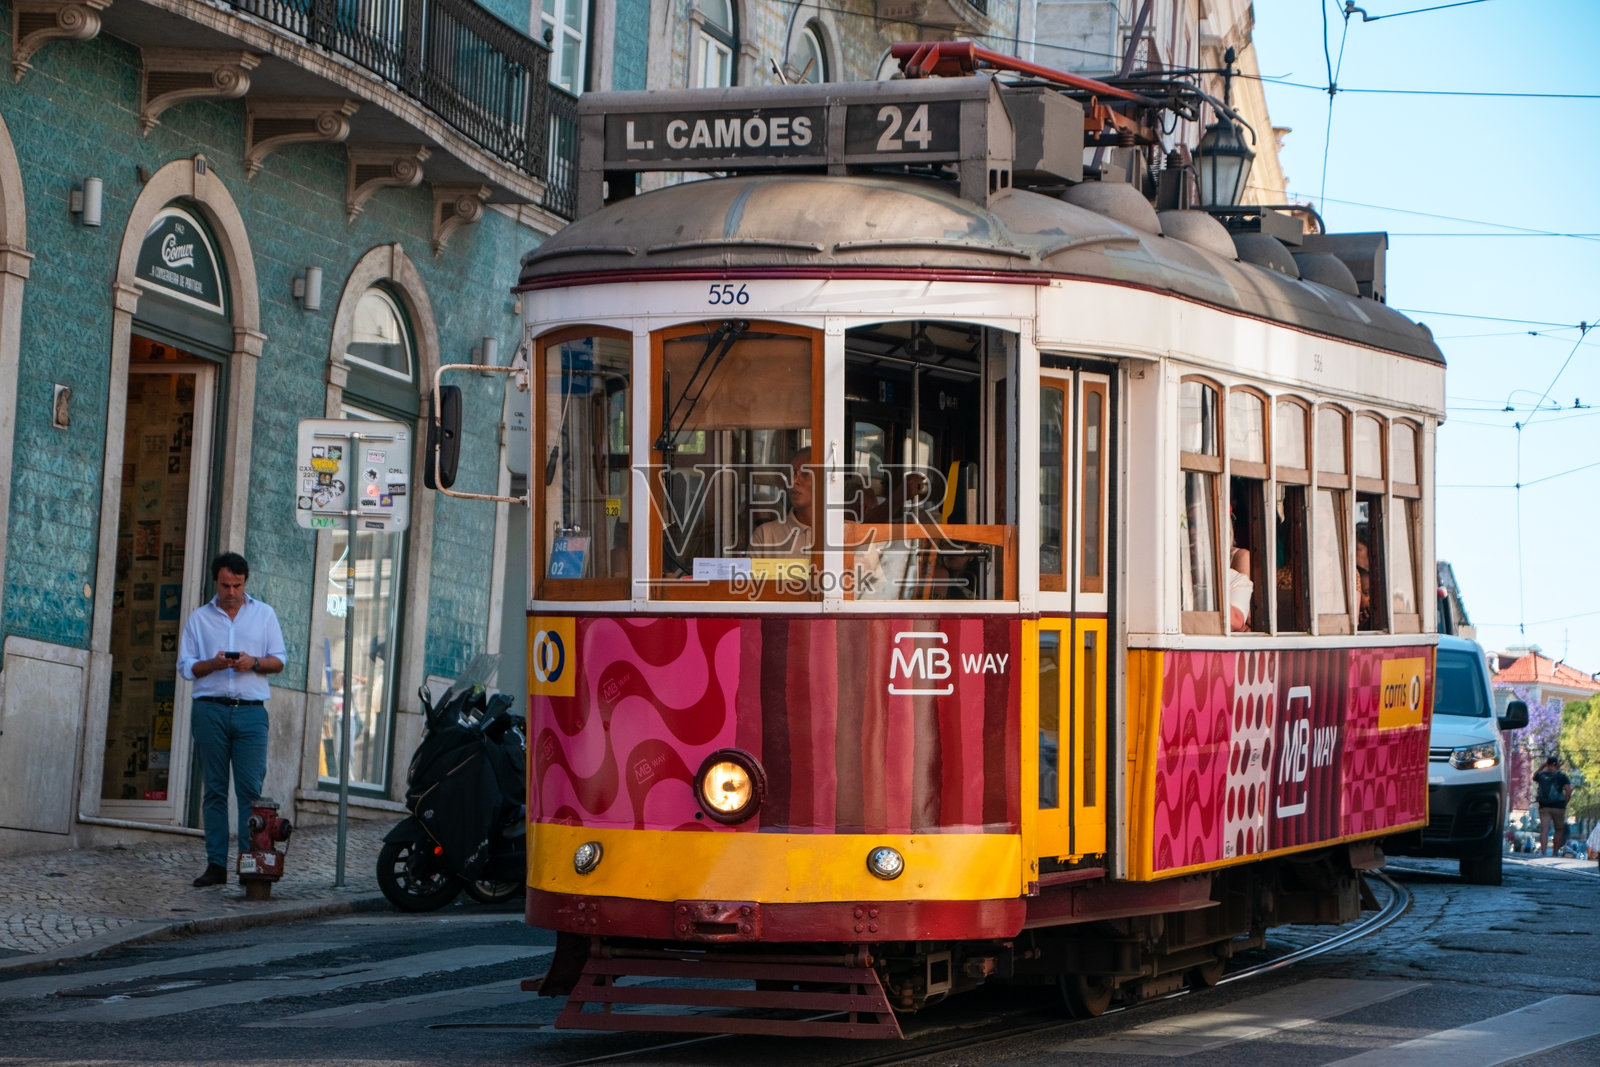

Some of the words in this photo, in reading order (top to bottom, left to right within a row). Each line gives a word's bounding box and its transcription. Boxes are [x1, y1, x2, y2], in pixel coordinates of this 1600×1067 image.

[626, 120, 654, 150] L.
[876, 104, 932, 152] 24
[179, 274, 185, 287] DE
[708, 283, 750, 305] 556
[551, 561, 564, 575] 02
[889, 649, 951, 680] MB
[961, 653, 1010, 674] WAY
[1278, 718, 1310, 786] MB
[1312, 725, 1338, 768] WAY
